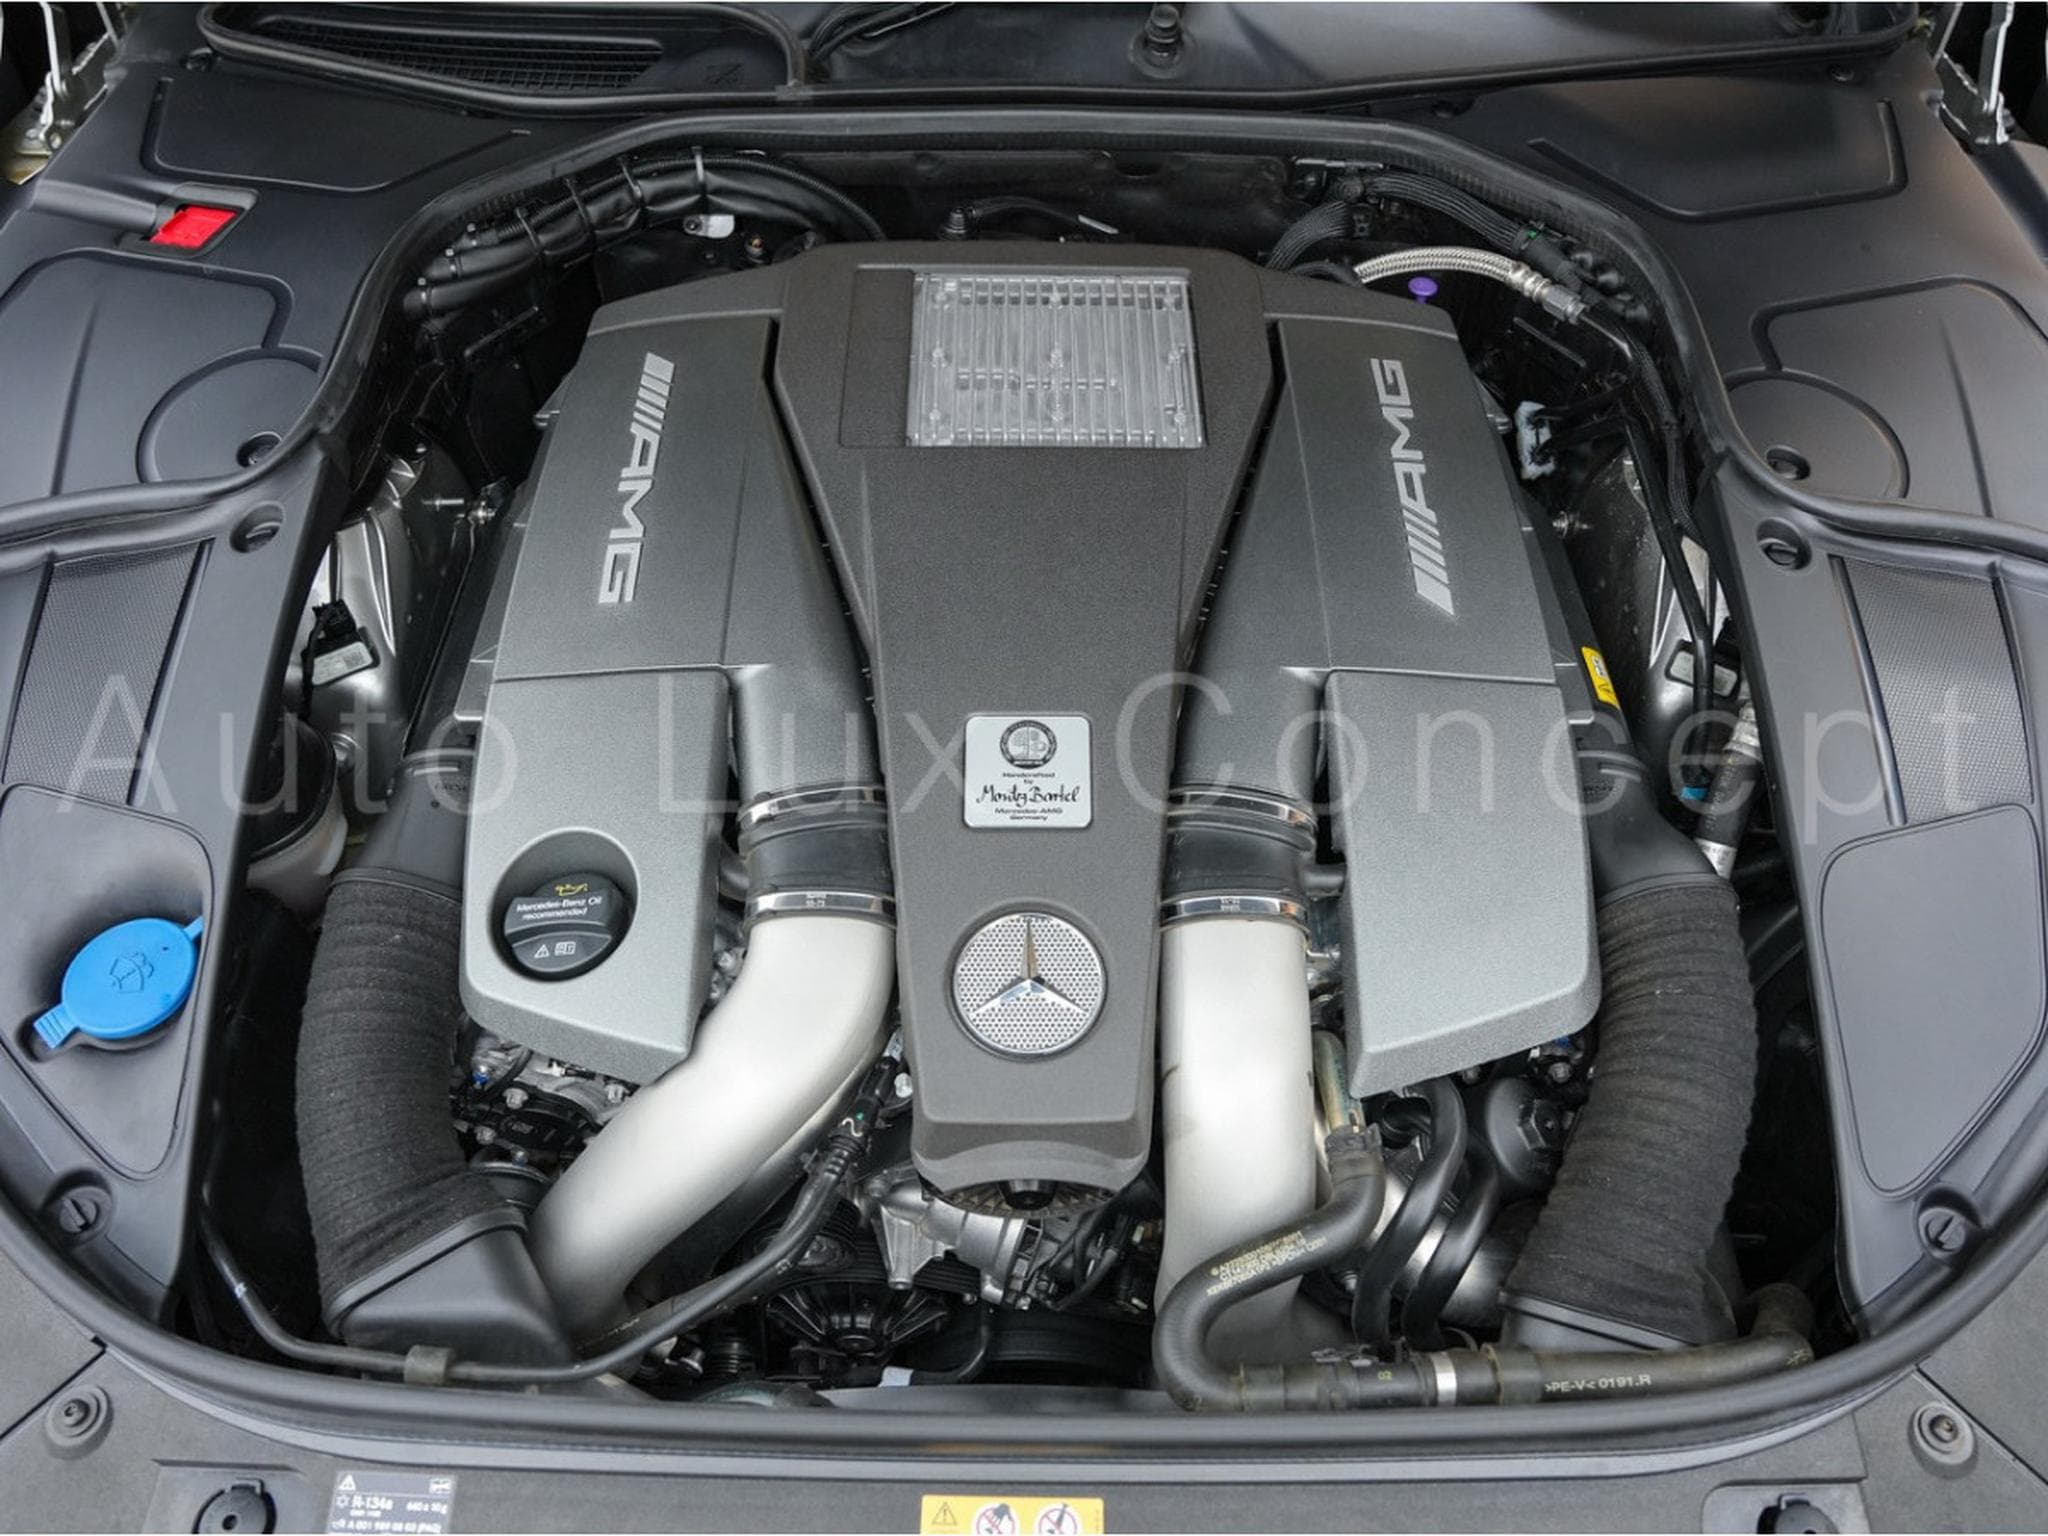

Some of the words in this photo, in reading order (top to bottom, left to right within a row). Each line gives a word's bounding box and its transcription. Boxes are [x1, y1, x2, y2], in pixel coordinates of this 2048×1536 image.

[516, 899, 587, 912] Mercedes-Benz
[587, 896, 602, 906] Oil
[522, 907, 588, 920] recommended
